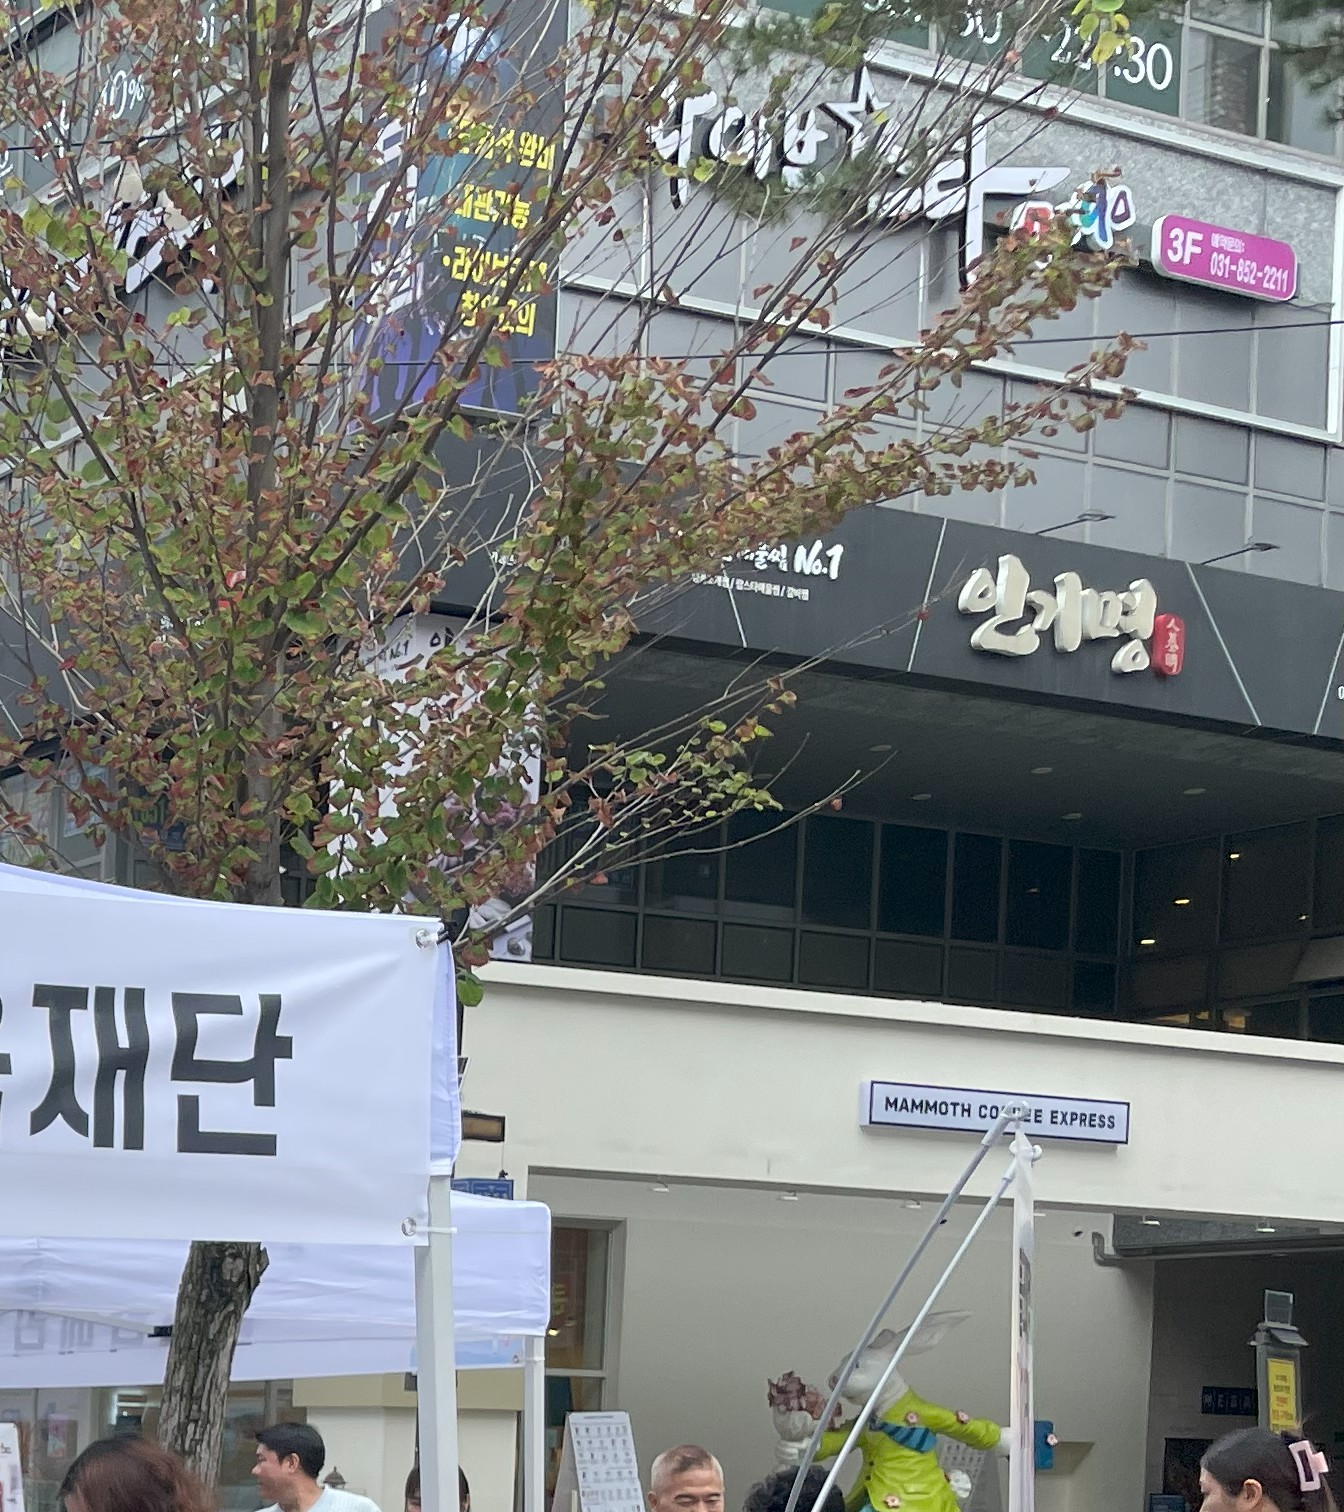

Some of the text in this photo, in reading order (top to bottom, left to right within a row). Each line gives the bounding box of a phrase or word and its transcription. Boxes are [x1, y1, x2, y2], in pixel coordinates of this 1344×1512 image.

[1167, 227, 1204, 265] 3F
[1210, 251, 1289, 293] 031-852-2211
[794, 539, 844, 581] No.1
[958, 554, 1158, 674] 인기명
[885, 1096, 972, 1119] MAMMOTH
[1050, 1109, 1116, 1130] EXPRESS
